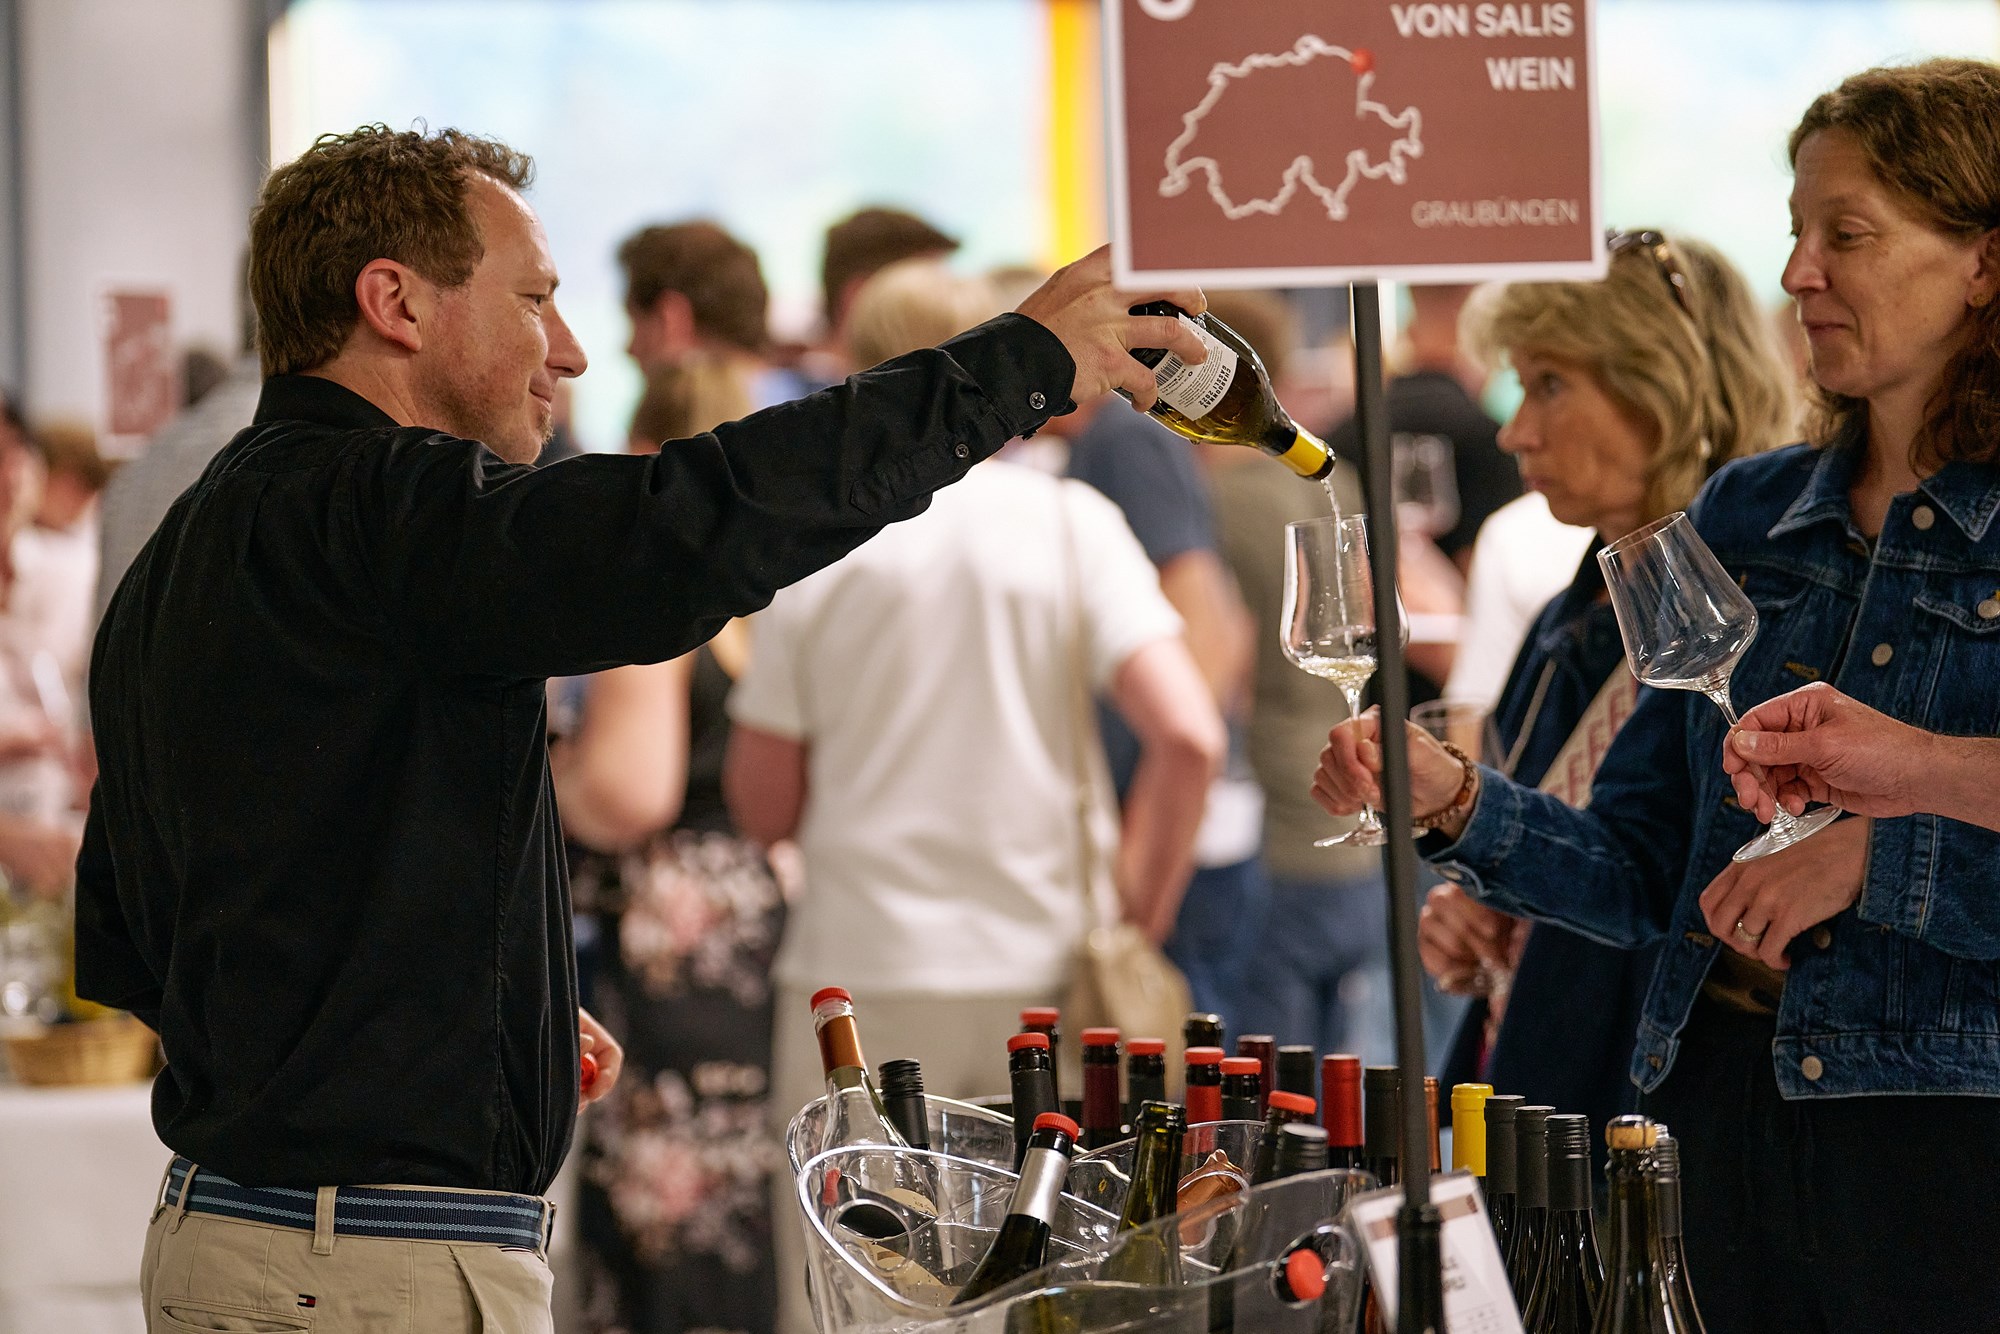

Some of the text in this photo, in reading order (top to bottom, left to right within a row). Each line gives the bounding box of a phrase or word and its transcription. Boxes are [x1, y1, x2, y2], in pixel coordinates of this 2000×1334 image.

[1390, 2, 1574, 38] VON SALIS
[1485, 56, 1575, 91] WEIN
[1411, 196, 1579, 228] GRAUBÜNDEN
[1203, 367, 1231, 408] CHARDONNAY
